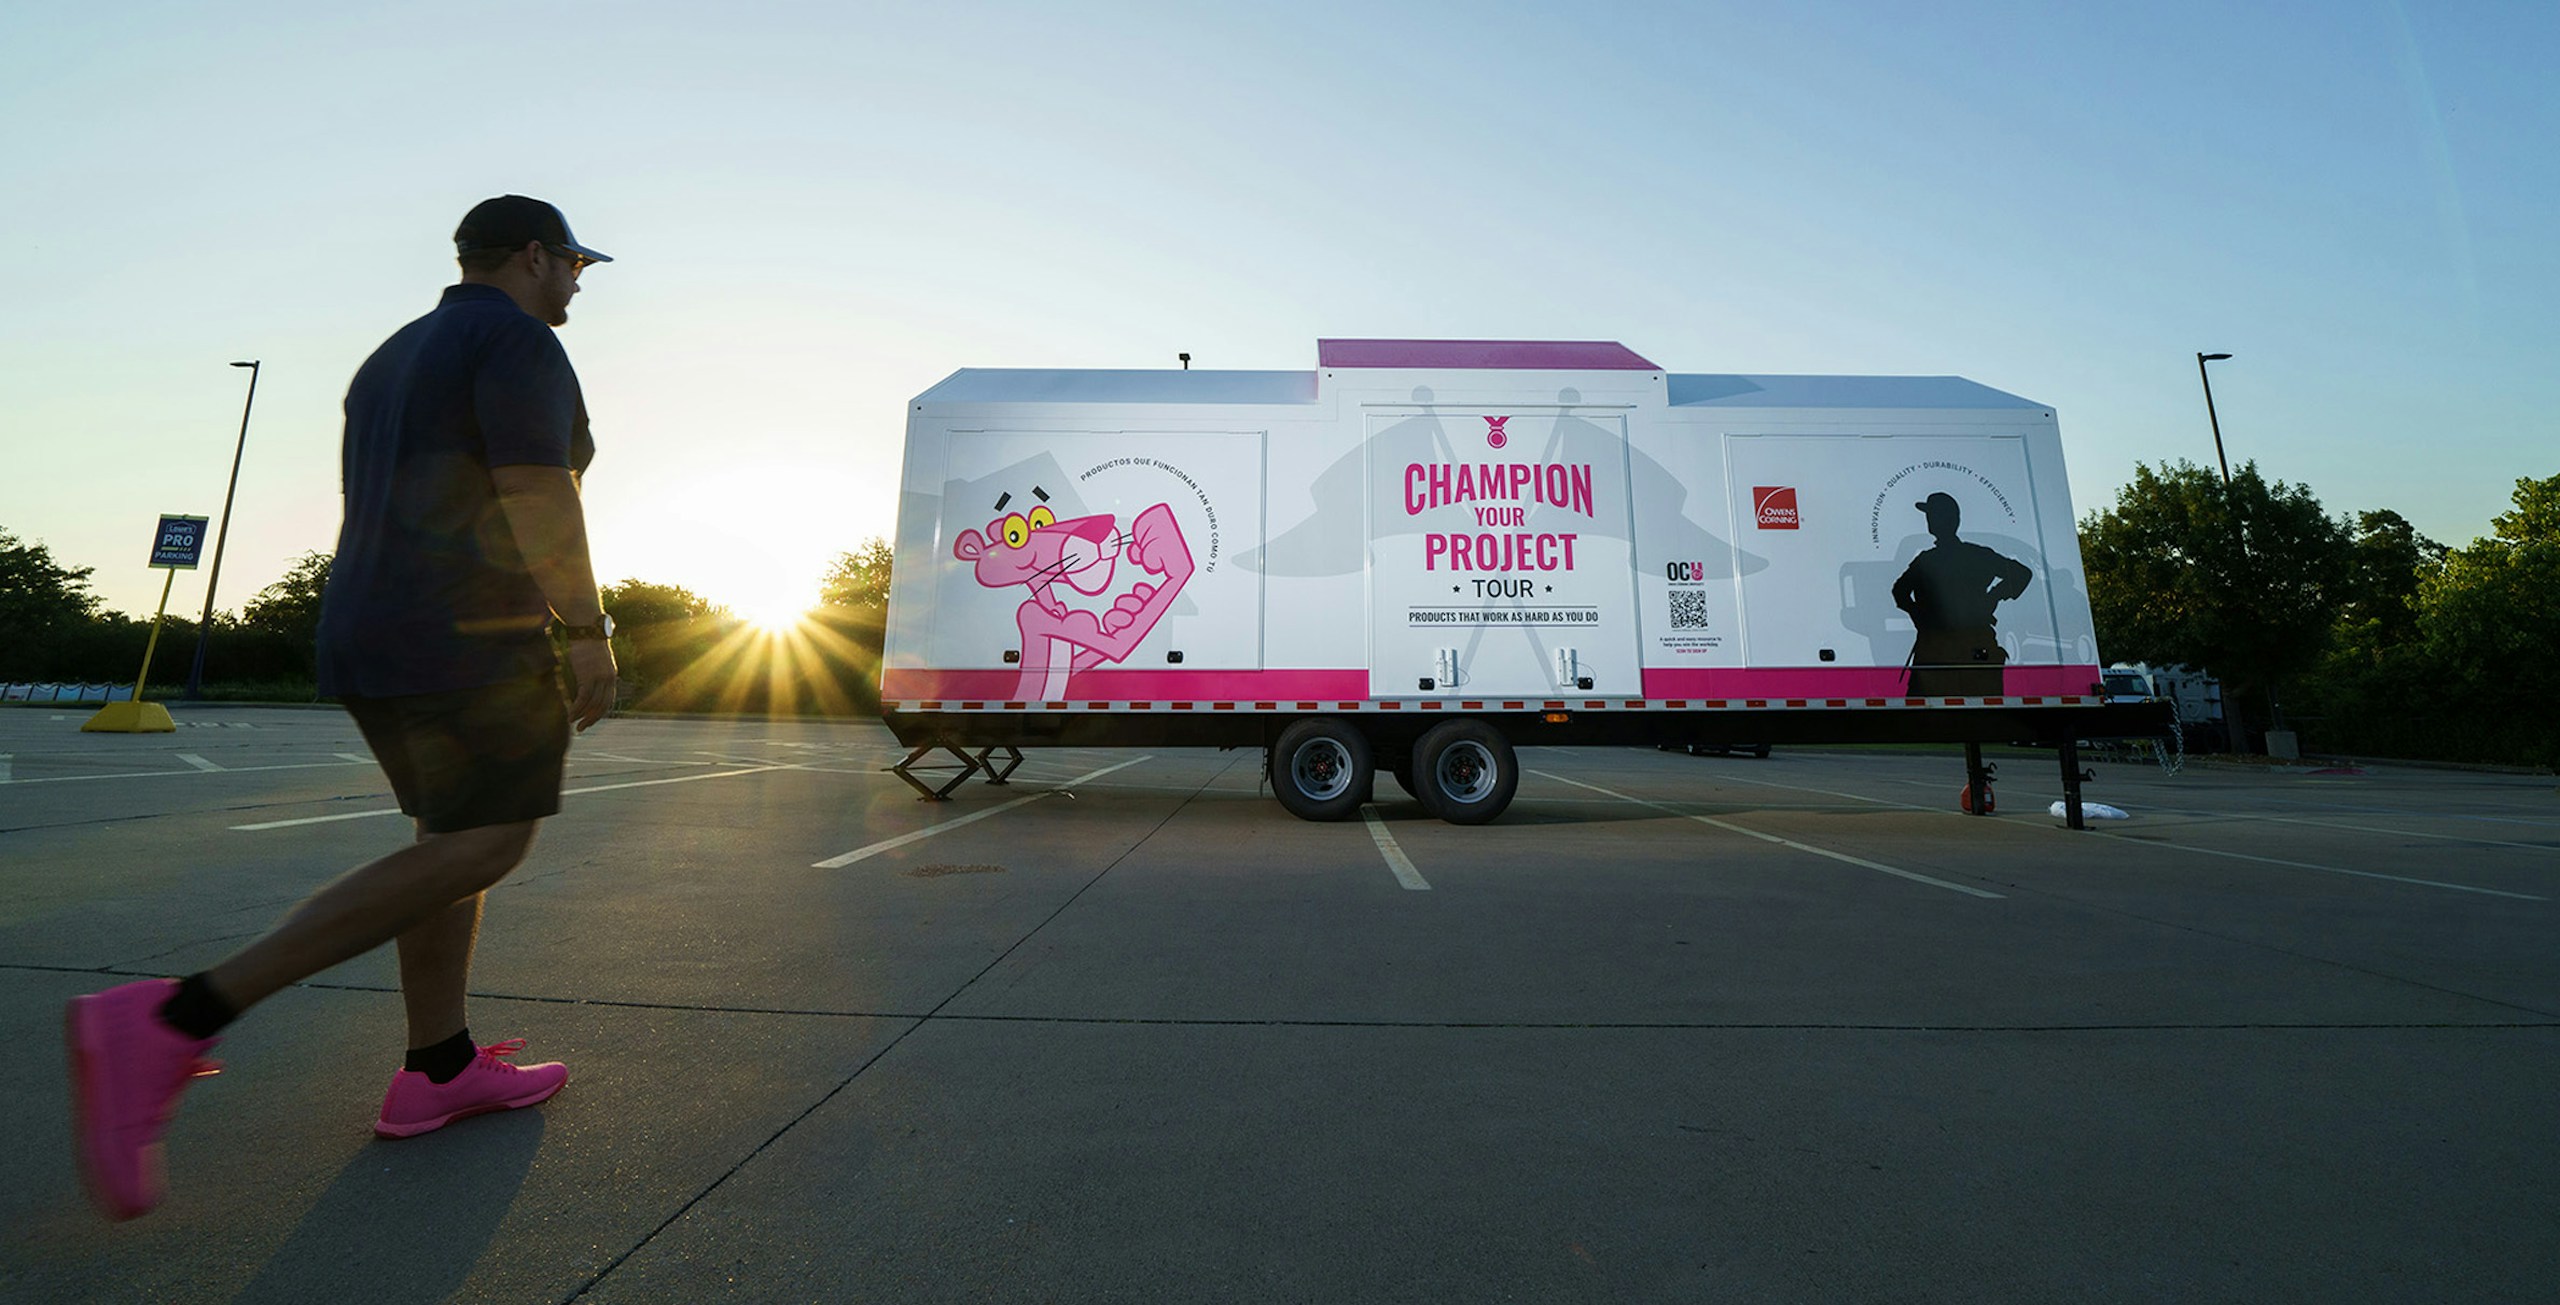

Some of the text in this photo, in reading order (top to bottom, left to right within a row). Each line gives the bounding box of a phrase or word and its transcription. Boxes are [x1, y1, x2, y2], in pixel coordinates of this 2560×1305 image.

[1080, 458, 1131, 481] PRODUCTOS
[1133, 457, 1151, 466] QUE
[1153, 459, 1198, 490] FUNCIONAN
[1196, 489, 1210, 506] TAN
[1404, 463, 1594, 518] CHAMPION
[1764, 507, 1796, 516] OWENS
[1871, 461, 2015, 543] INNOVATION QUALITY DURABILITY EFFICIENCY
[1205, 506, 1218, 530] DURO
[1474, 507, 1525, 526] YOUR
[1758, 515, 1798, 524] CORNING
[162, 534, 194, 547] PRO
[1210, 531, 1219, 559] COMO
[154, 551, 194, 560] PARKING
[1426, 533, 1577, 572] PROJECT
[1667, 562, 1704, 581] OCU
[1472, 580, 1534, 598] TOUR
[1409, 612, 1599, 622] PRODUCTS THAT WORK AS HARD AS YOU DO
